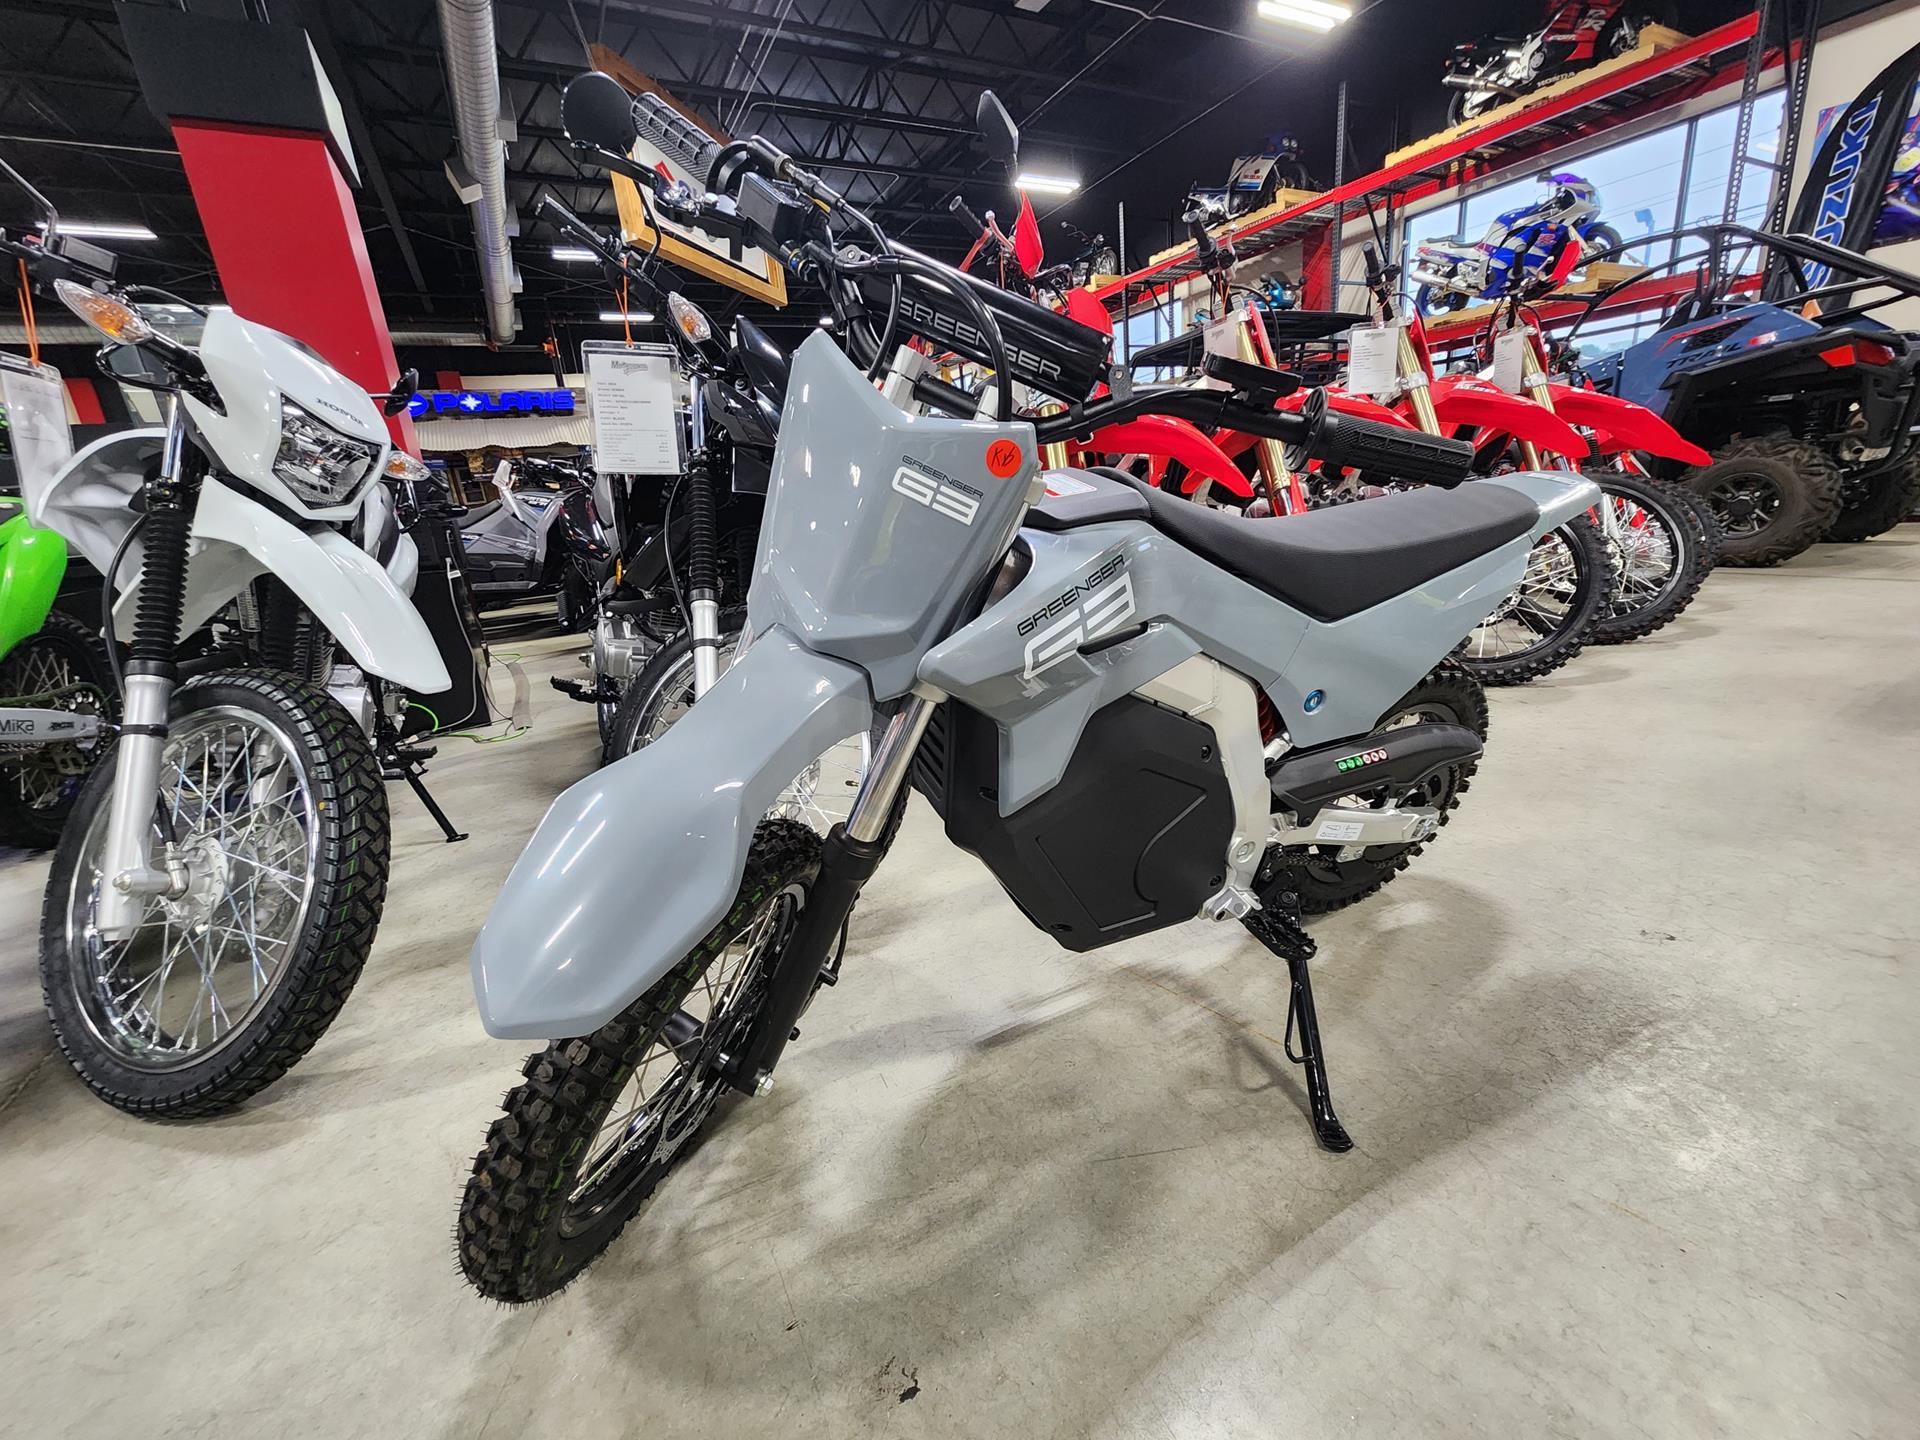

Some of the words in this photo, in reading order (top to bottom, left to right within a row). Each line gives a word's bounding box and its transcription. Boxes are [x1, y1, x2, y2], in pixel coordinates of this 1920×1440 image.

[432, 390, 575, 413] POLARIS
[902, 454, 984, 499] GREENGER
[1017, 554, 1125, 637] GREENGER
